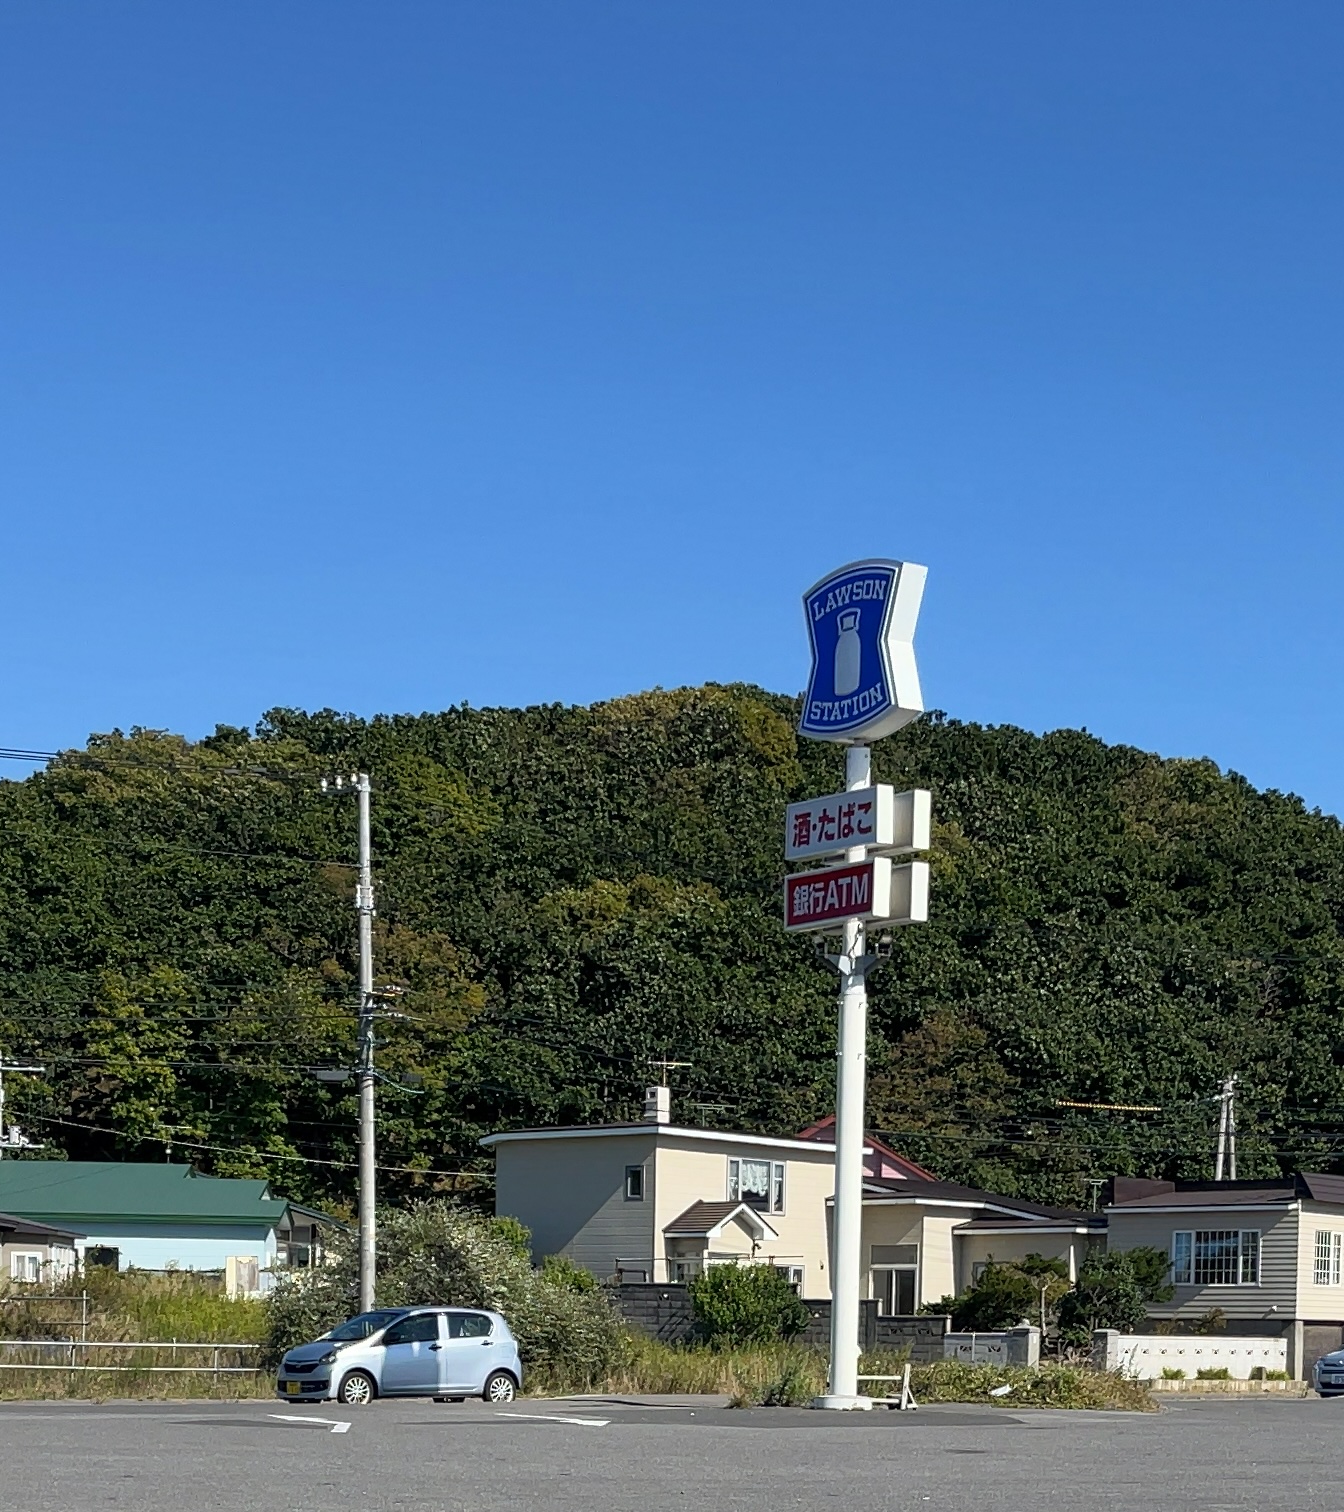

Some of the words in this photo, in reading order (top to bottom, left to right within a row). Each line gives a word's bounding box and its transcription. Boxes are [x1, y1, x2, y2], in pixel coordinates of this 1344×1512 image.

[813, 579, 887, 621] LAWSON
[810, 682, 884, 721] STATION
[792, 801, 873, 848] 酒・たばこ
[792, 872, 869, 917] 銀行ATM
